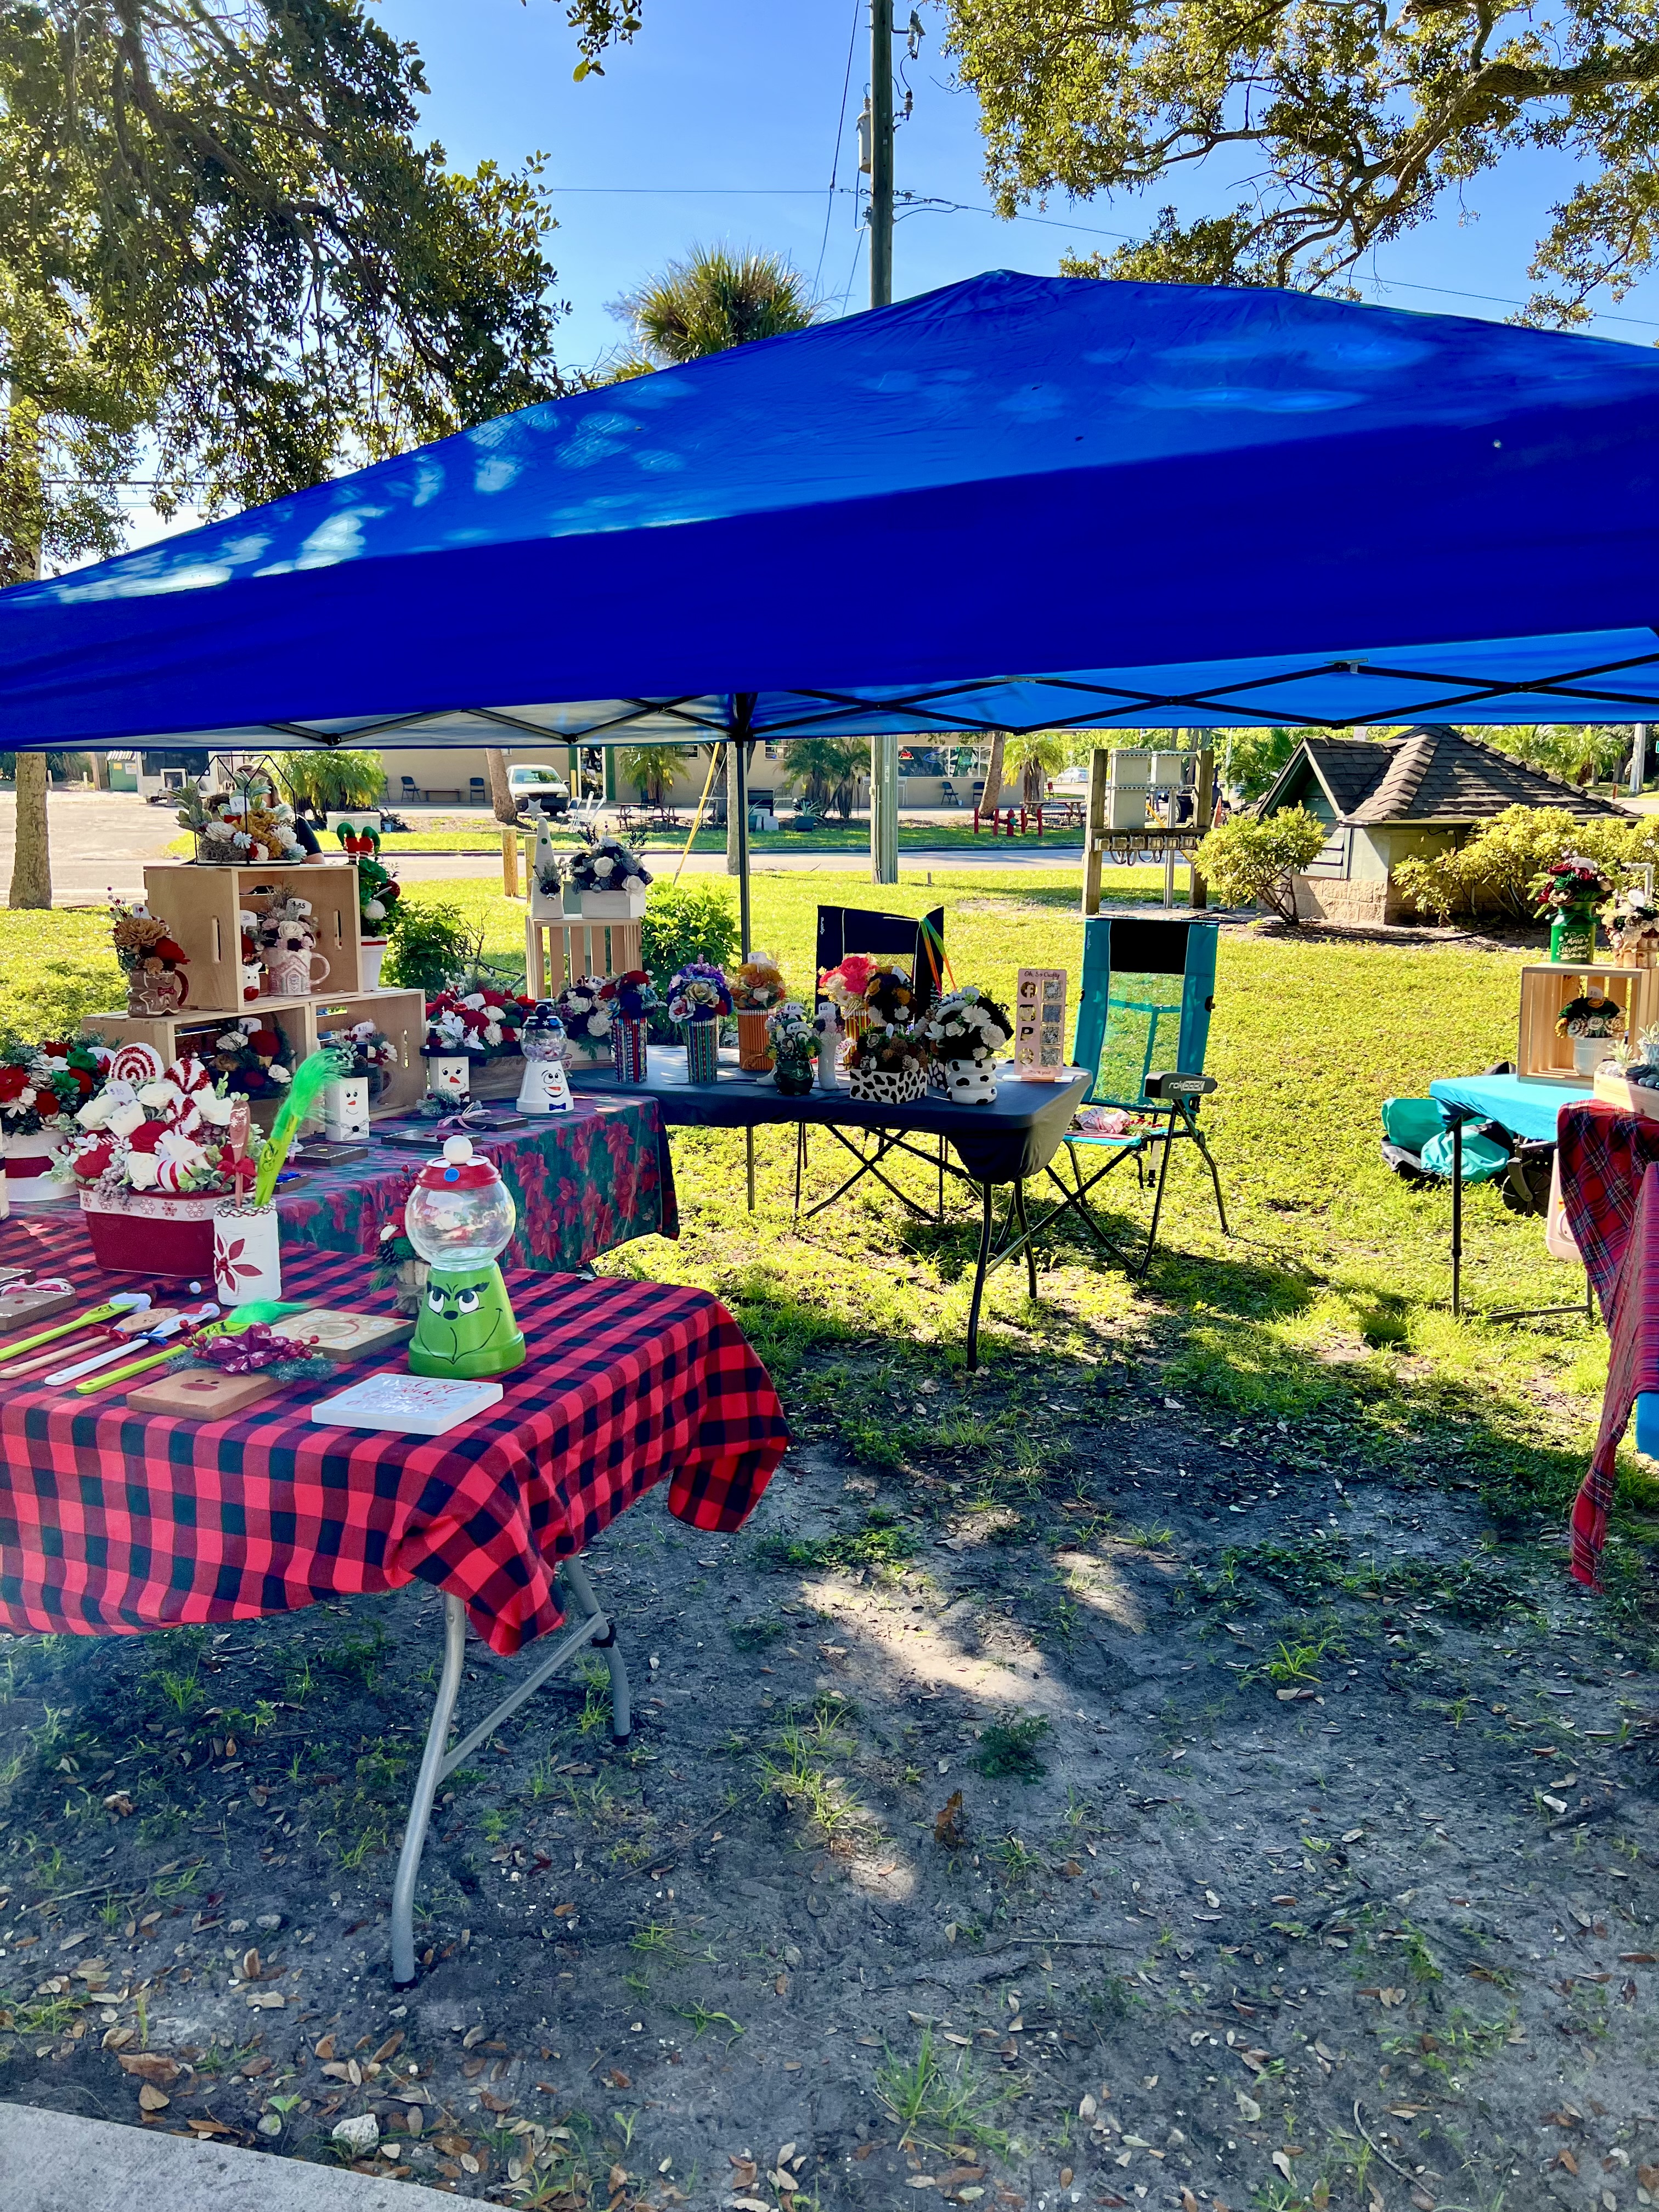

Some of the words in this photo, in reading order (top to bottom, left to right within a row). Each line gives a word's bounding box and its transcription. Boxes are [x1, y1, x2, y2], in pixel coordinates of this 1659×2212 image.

[1562, 932, 1585, 945] Merry
[1557, 943, 1590, 953] Christmas
[1043, 972, 1060, 980] Crafty
